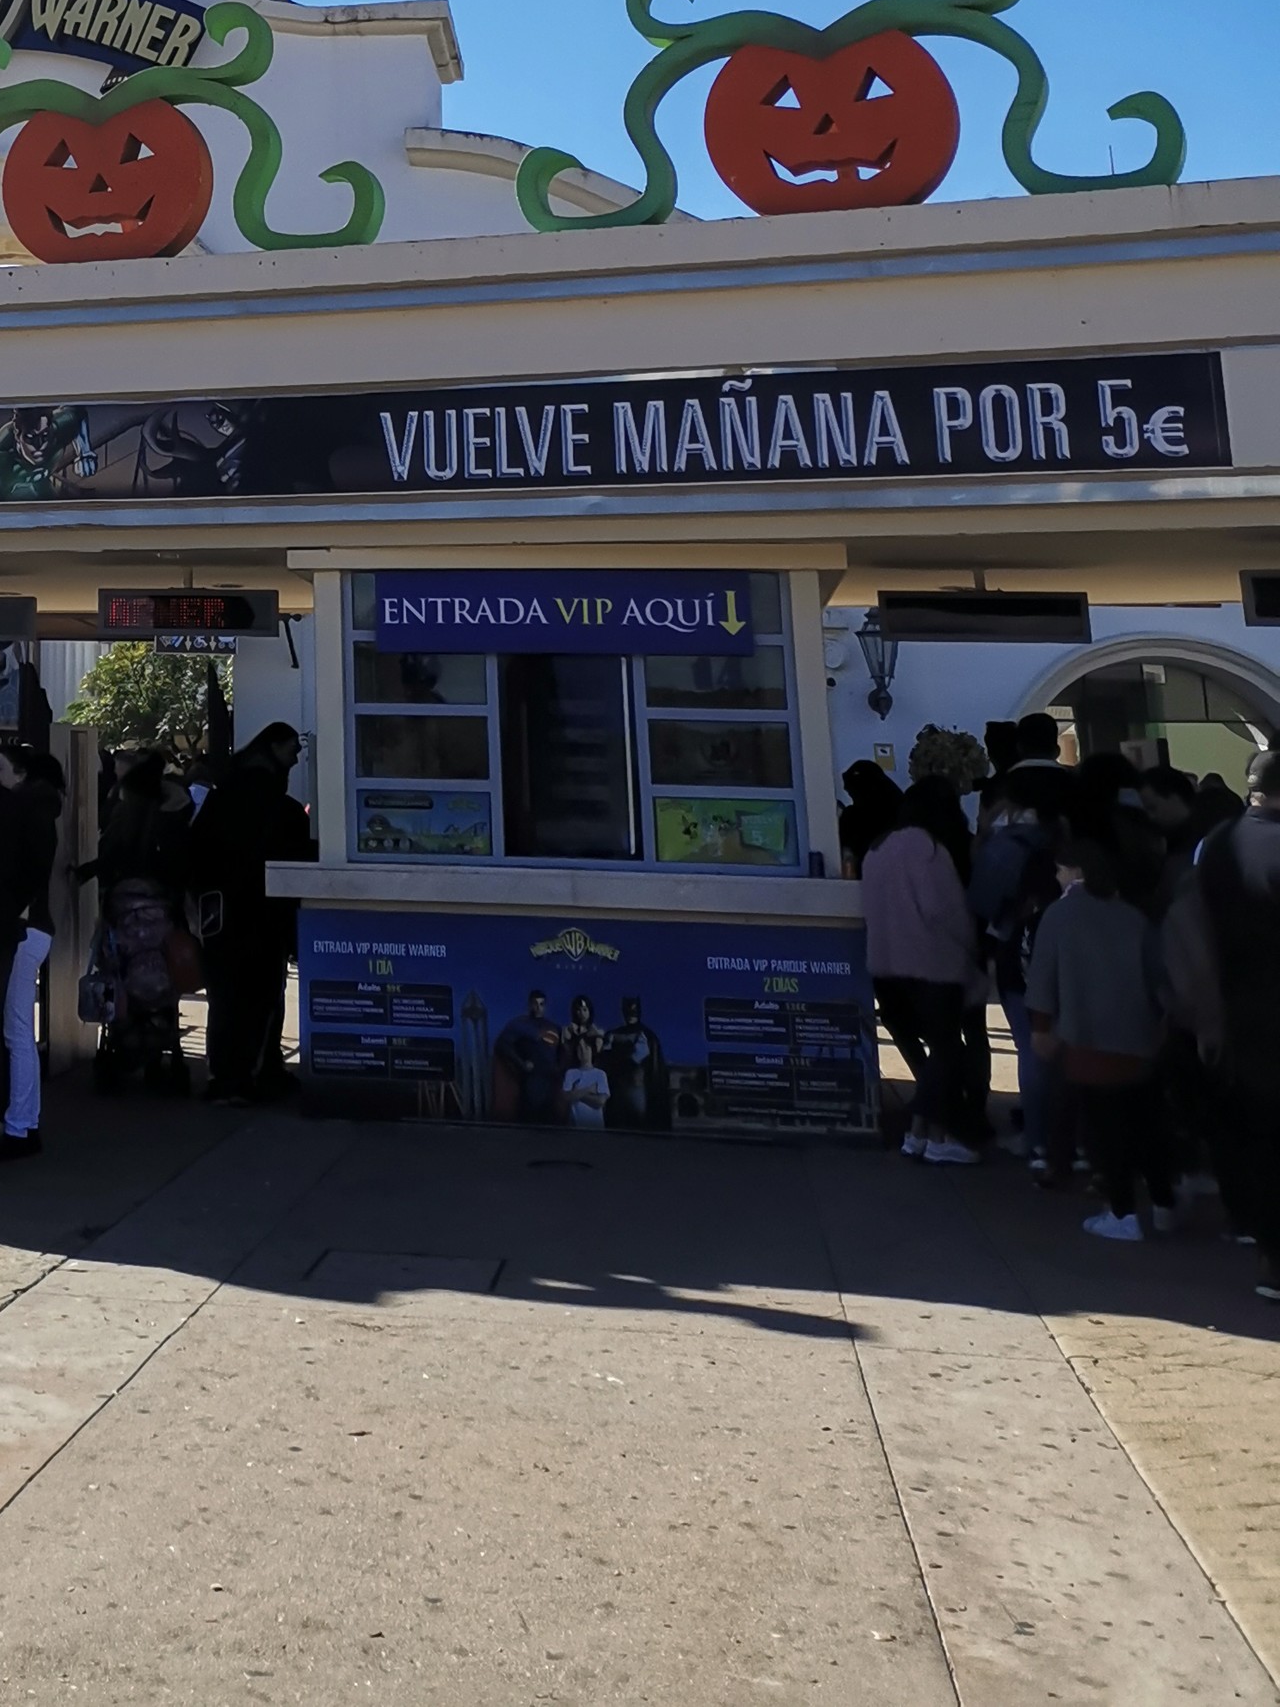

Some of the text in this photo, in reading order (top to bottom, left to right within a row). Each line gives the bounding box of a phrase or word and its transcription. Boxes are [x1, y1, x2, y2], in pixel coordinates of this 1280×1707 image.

[380, 378, 1190, 482] VUELVE MAÑANA POR 5€
[383, 592, 715, 633] ENTRADA VIP AQUÍ
[313, 940, 447, 957] ENTRADA VIP PARQUE WARNER
[707, 956, 851, 975] ENTRADA VIP PARQUE WARNER
[763, 977, 771, 993] 2
